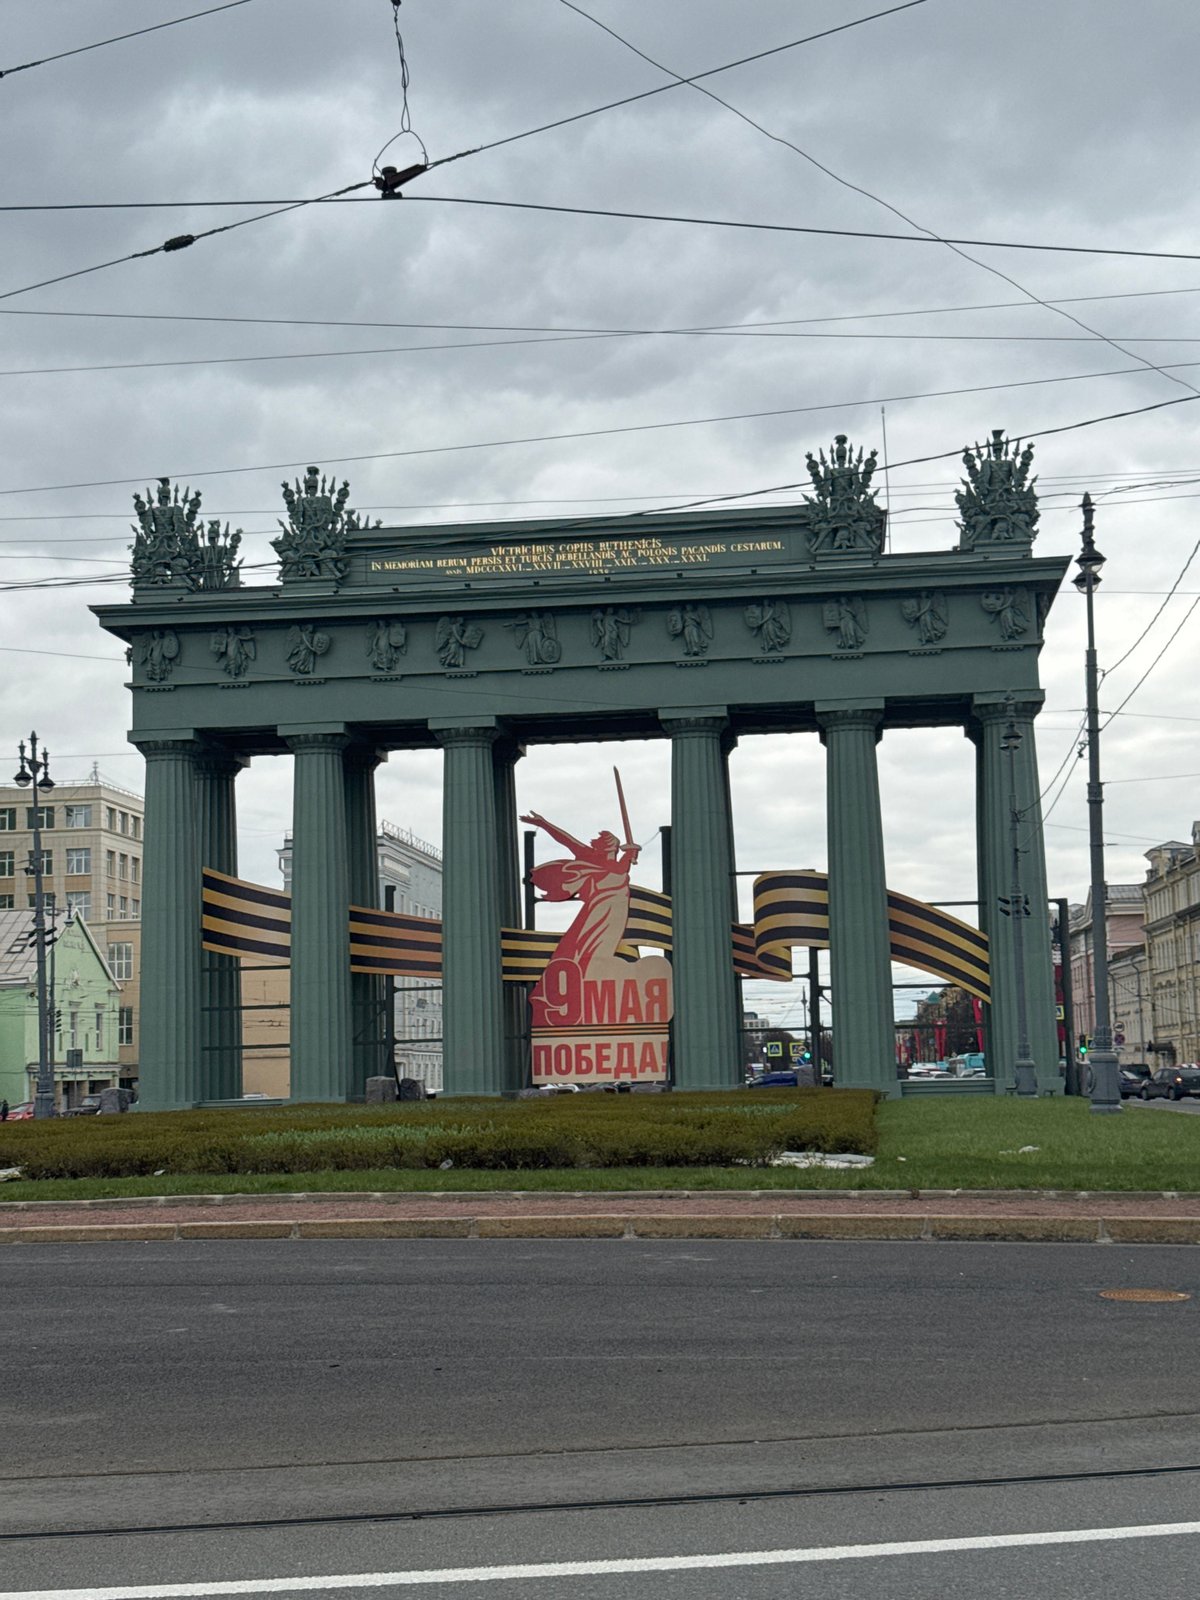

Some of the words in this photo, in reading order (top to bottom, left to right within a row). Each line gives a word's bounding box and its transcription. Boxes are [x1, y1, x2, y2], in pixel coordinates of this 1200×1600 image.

[371, 561, 382, 571] IN
[384, 559, 434, 570] MEMORIAM
[437, 558, 467, 568] RERUM
[471, 555, 502, 566] PERSIS
[505, 556, 517, 564] ET
[521, 553, 553, 564] TURCIS
[556, 550, 616, 562] DEBELLANDIS
[621, 550, 633, 558] AC
[638, 546, 678, 558] POLONIS
[681, 543, 726, 555] PACANDIS
[490, 544, 555, 556] VICTRICIBUS
[559, 542, 594, 553] COPIIS
[599, 538, 662, 551] RUTHENICIS
[544, 959, 582, 1025] 9
[583, 978, 668, 1025] МАЯ
[533, 1041, 667, 1080] ПОБЕДА!
